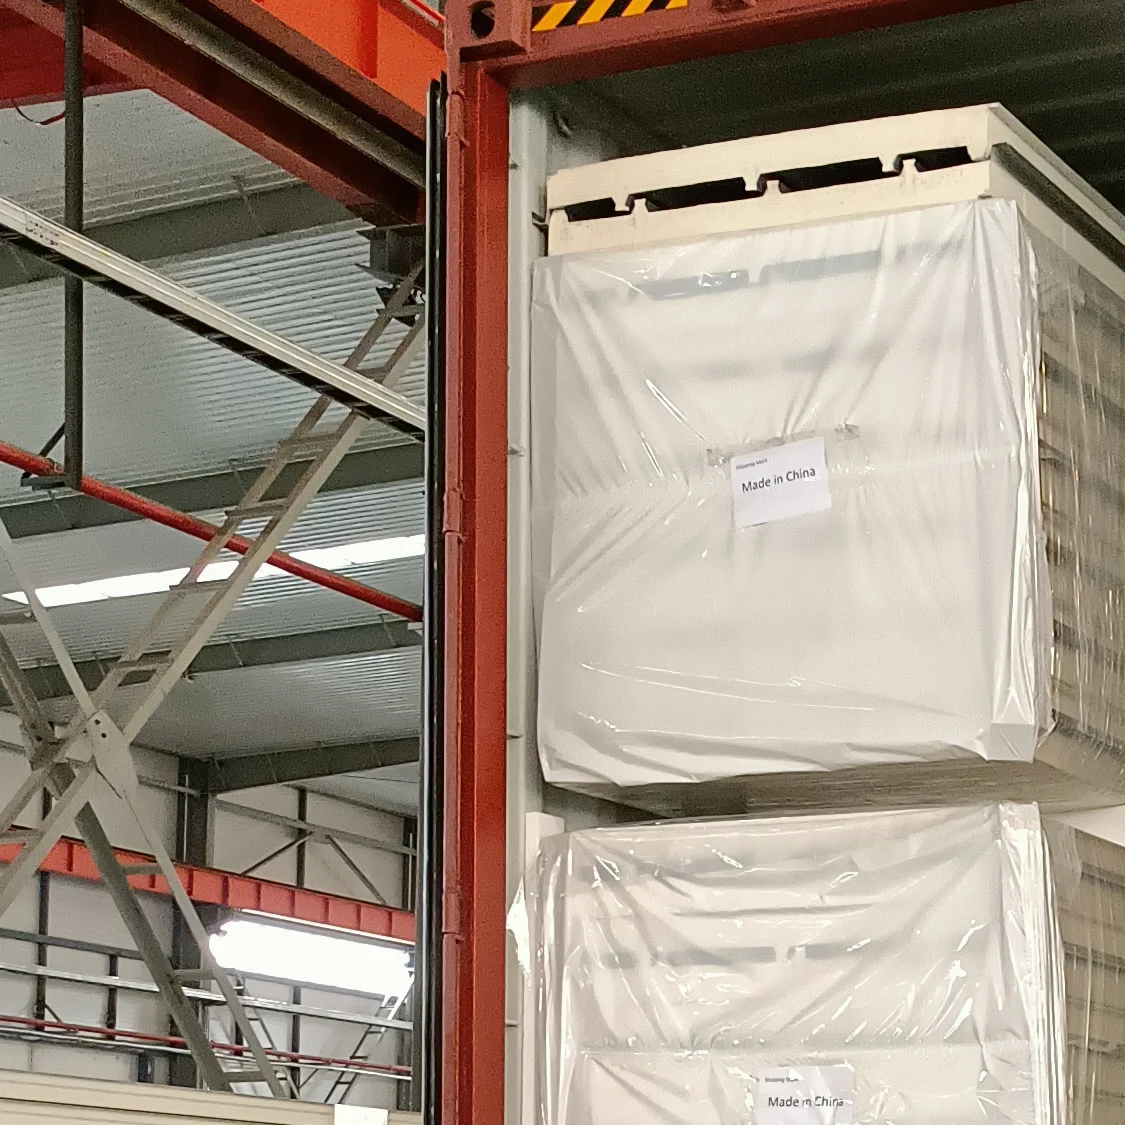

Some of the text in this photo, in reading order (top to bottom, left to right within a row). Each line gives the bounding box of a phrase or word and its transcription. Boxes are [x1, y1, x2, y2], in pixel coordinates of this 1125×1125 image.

[742, 467, 816, 493] Made in China
[768, 1096, 800, 1107] Made
[815, 1096, 844, 1107] China
